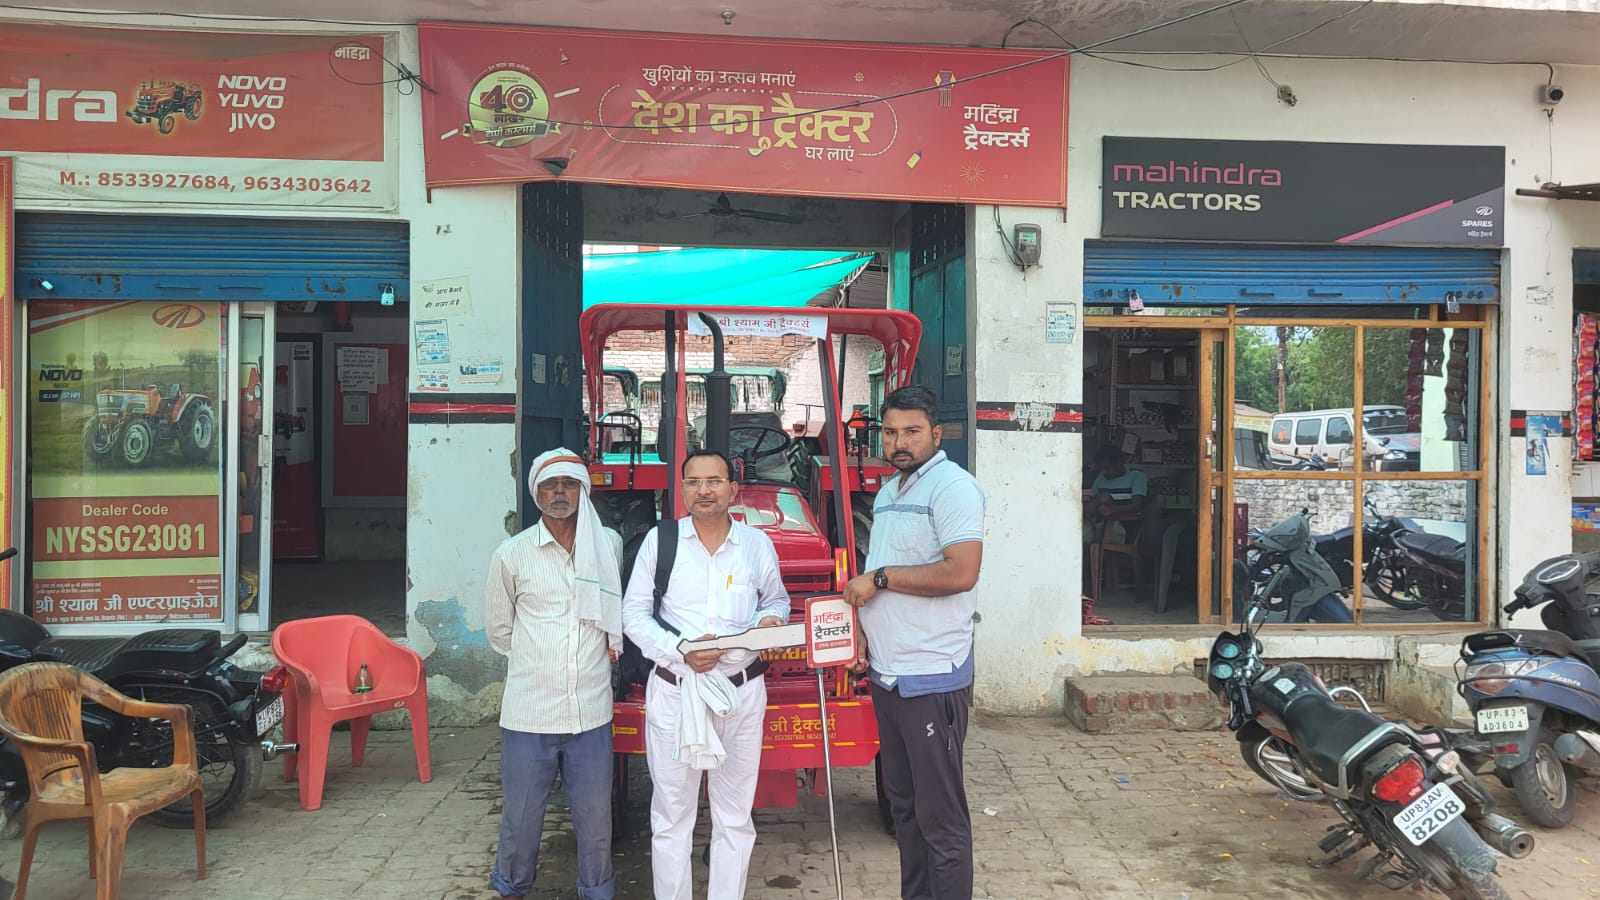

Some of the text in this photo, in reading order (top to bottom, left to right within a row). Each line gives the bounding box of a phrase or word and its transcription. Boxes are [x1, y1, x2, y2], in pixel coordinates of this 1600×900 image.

[218, 75, 287, 91] NOVO
[642, 65, 797, 87] खुशियों का उत्सव मनाएं
[218, 93, 284, 109] YUVO
[229, 113, 275, 132] JIVO
[631, 89, 875, 149] देश का ट्रैक्टर
[963, 103, 1020, 124] महिंद्रा
[963, 123, 1031, 150] ट्रैक्टर्स
[805, 145, 856, 162] घर लाएं
[98, 172, 236, 191] 8533927684,
[243, 176, 371, 193] 9634303642
[1113, 160, 1282, 186] mahindra
[1113, 191, 1262, 212] TRACTORS
[1462, 219, 1494, 228] SPARES
[734, 319, 761, 328] श्याम
[764, 318, 776, 329] जी
[40, 369, 83, 381] NOVO
[82, 503, 169, 517] Dealer Code
[46, 523, 206, 554] NYSSG23081
[36, 595, 54, 613] श्री
[59, 598, 99, 613] श्याम
[103, 593, 122, 611] जी
[814, 621, 851, 640] ट्रैक्टर्स
[769, 716, 788, 732] जी
[1400, 787, 1444, 823] UP83AV
[1411, 799, 1460, 841] 8208
